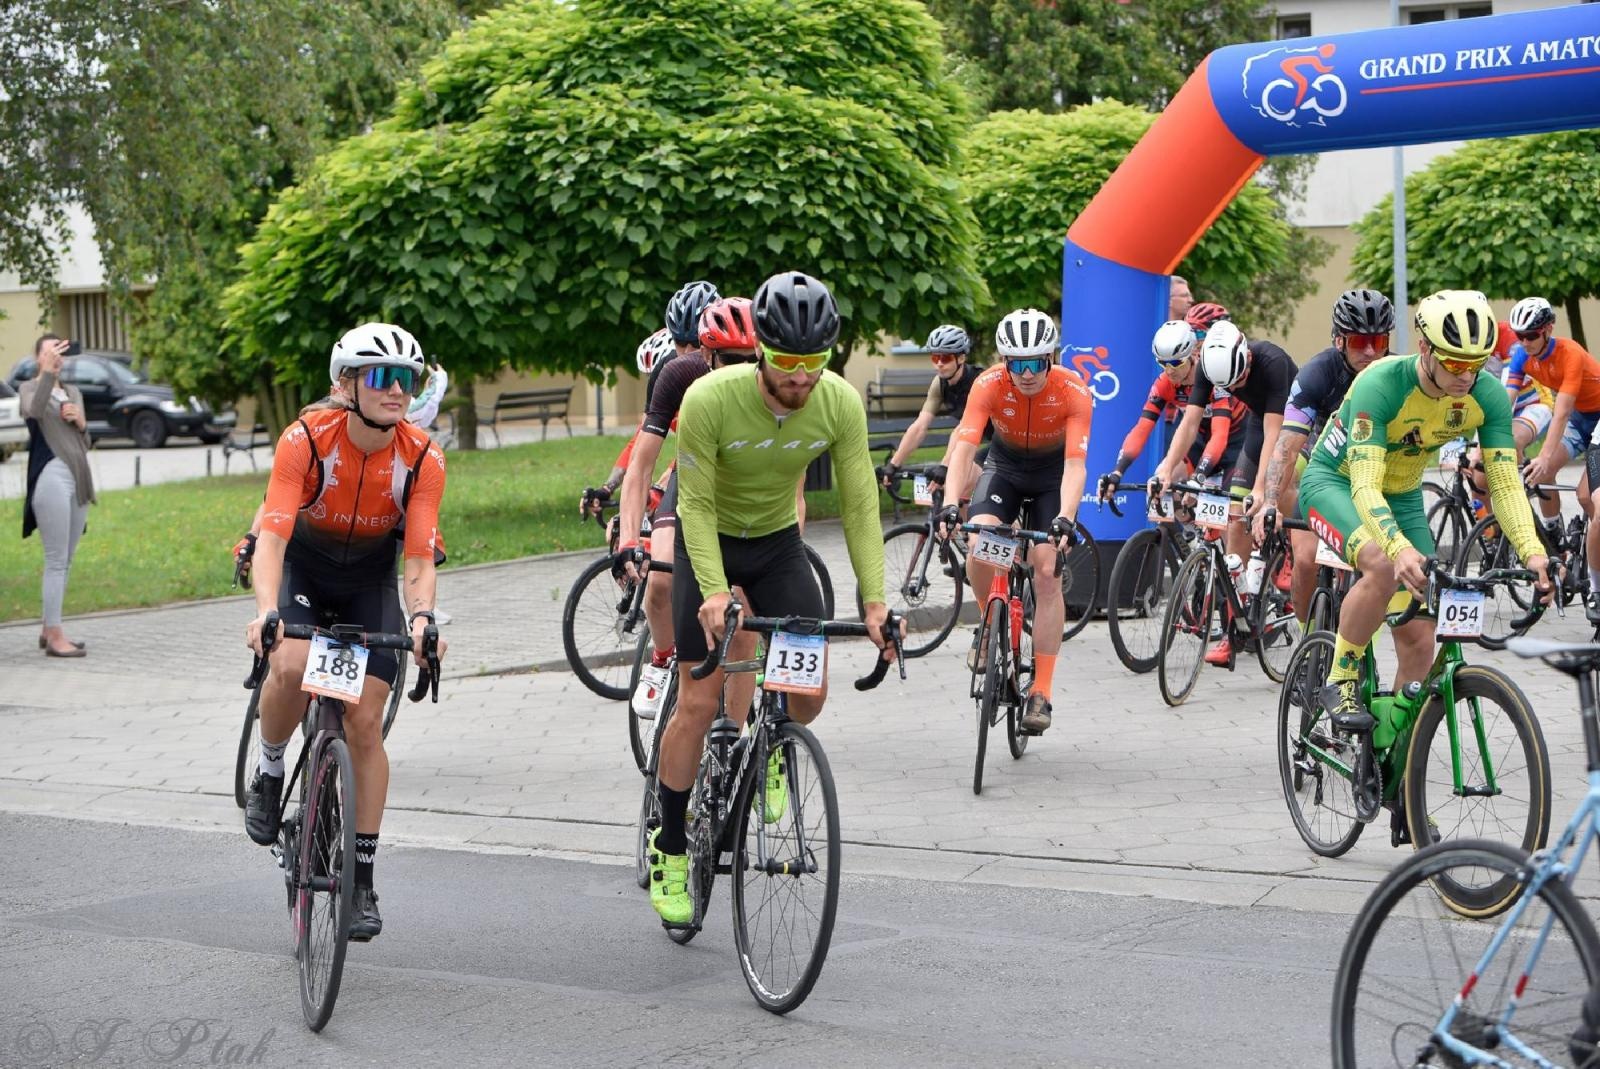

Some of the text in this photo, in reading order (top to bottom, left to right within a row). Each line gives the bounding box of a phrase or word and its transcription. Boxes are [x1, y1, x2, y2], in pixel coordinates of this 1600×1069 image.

[1360, 53, 1447, 80] GRAND
[1455, 45, 1513, 72] PRIX
[726, 438, 829, 450] MAAP
[1202, 502, 1225, 517] 208
[980, 540, 1011, 558] 155
[1446, 604, 1479, 622] 054
[315, 654, 359, 681] 188
[776, 649, 819, 673] 133
